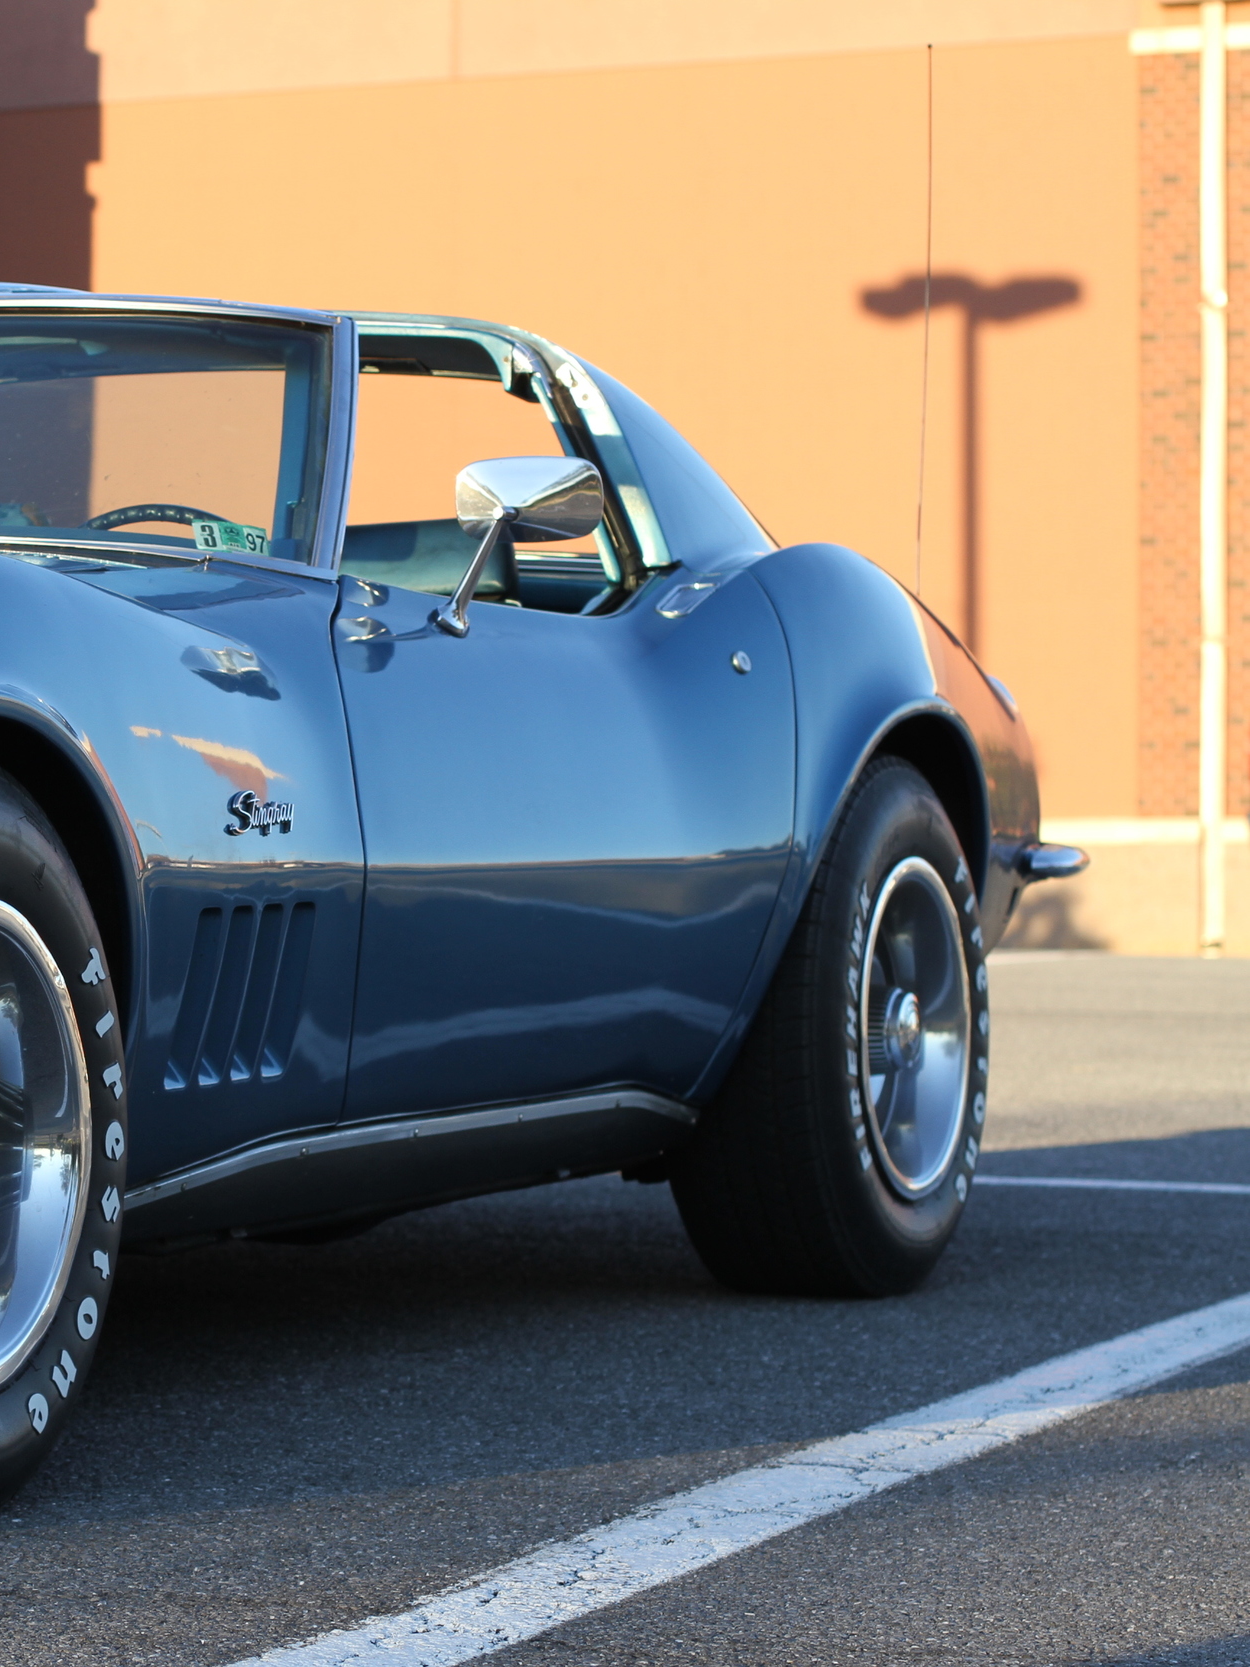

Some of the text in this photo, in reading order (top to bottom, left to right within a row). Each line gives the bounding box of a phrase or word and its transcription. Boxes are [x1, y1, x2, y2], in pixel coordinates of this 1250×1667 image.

[200, 524, 217, 548] 3
[246, 533, 265, 554] 97
[223, 790, 295, 836] Stingray
[27, 946, 125, 1435] Firestone
